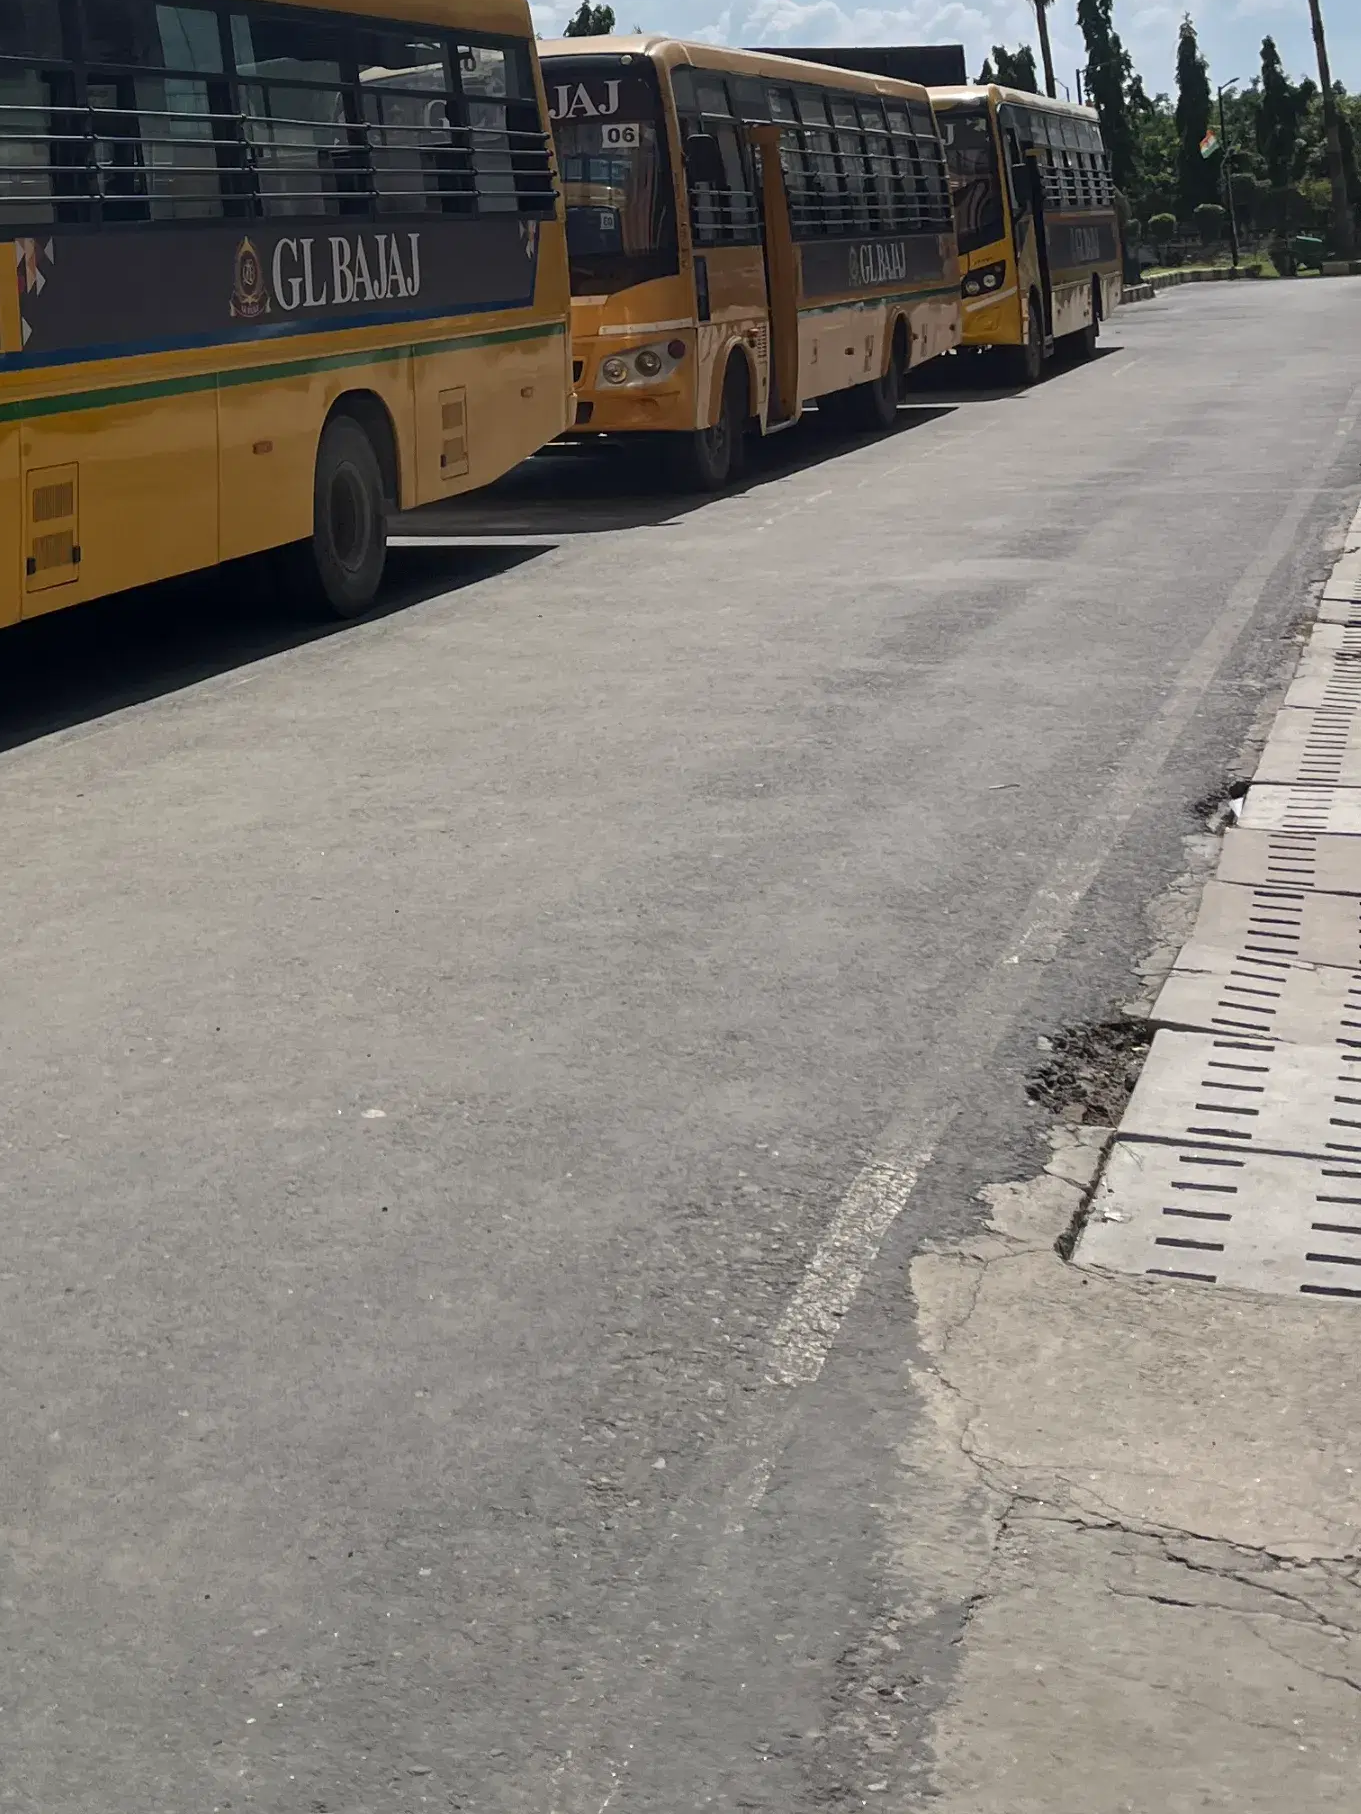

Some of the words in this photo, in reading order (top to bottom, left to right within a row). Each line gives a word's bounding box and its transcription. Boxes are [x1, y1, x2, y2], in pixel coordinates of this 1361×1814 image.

[548, 79, 622, 120] JAJ
[607, 127, 635, 144] 06
[272, 237, 327, 311] GL
[328, 233, 420, 305] BAJAJ
